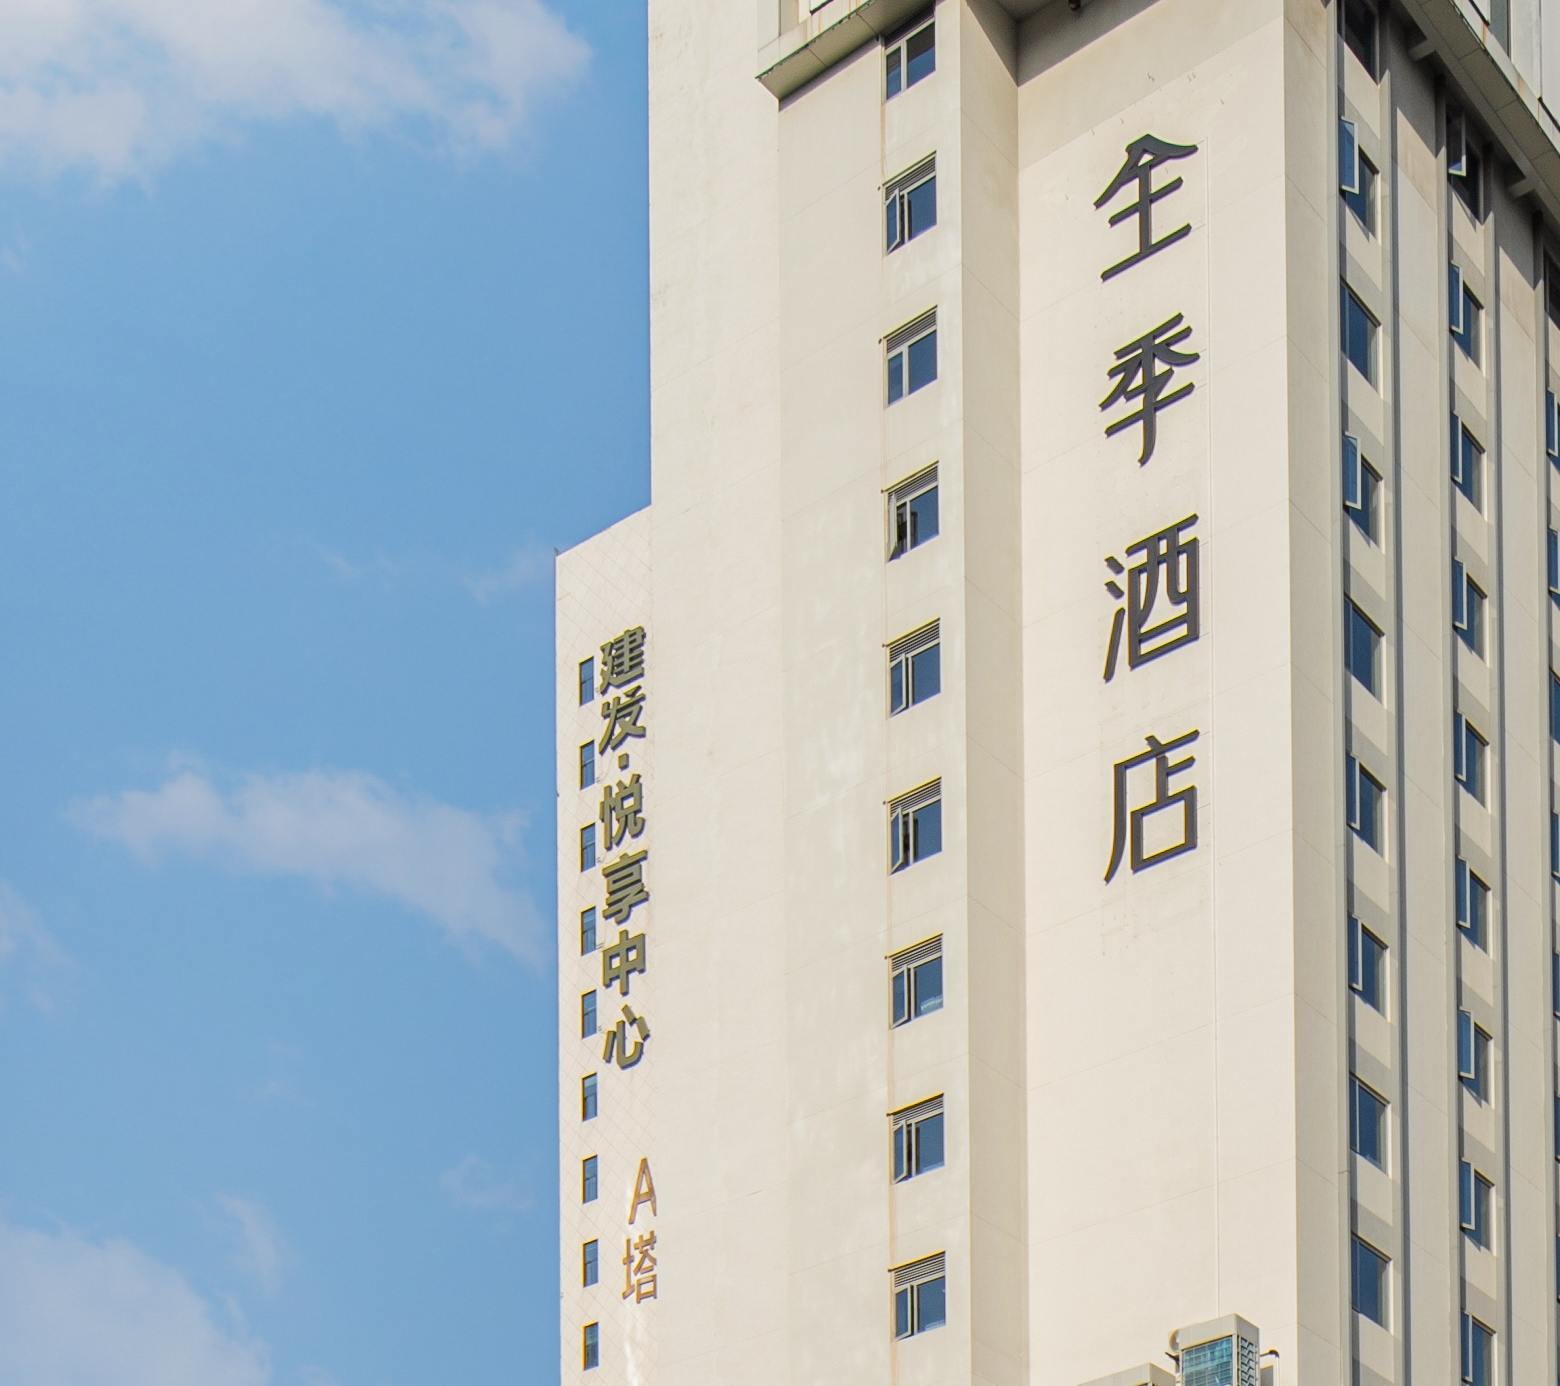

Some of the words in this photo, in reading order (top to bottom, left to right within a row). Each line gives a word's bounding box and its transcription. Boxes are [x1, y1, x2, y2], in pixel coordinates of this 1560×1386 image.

[1093, 133, 1201, 885] 全季酒店
[621, 1156, 659, 1305] A塔
